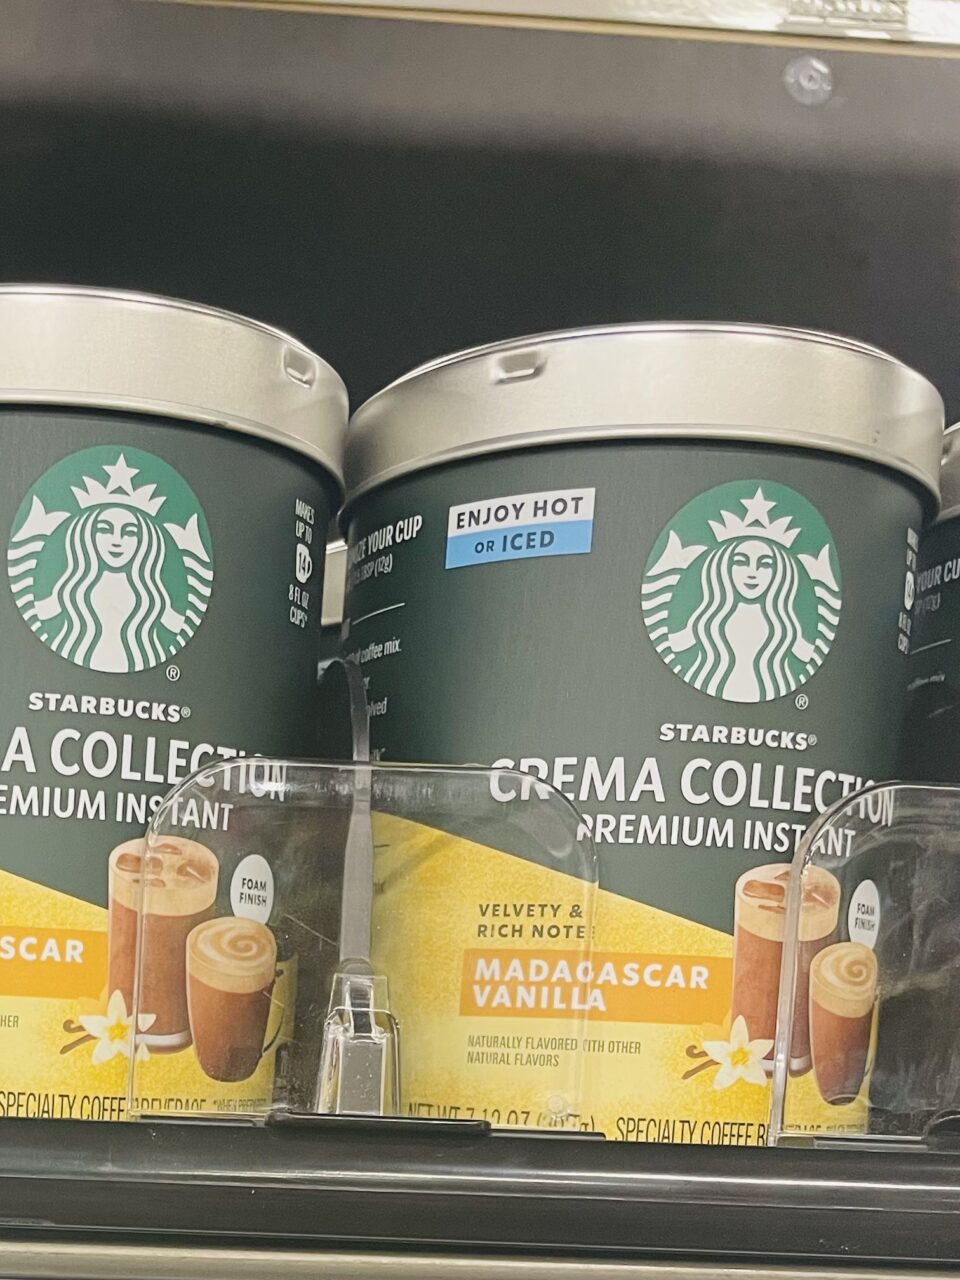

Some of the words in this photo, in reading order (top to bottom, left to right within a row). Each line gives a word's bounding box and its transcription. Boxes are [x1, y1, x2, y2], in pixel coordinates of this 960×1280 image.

[295, 498, 315, 525] MAKES
[456, 502, 526, 530] ENJOY
[532, 496, 584, 518] HOT
[367, 525, 393, 556] YOUR
[395, 514, 423, 544] CUP
[474, 540, 495, 554] OR
[502, 530, 555, 553] ICED
[360, 641, 383, 664] coffee
[51, 728, 286, 801] COLLECTION
[488, 756, 665, 802] CREMA
[680, 757, 895, 827] COLLECTION
[116, 792, 233, 831] INSTANT
[576, 813, 734, 849] PREMIUM
[743, 820, 856, 858] INSTANT
[241, 878, 267, 892] FOAM
[239, 892, 267, 907] FINISH
[478, 903, 562, 918] VELVETY
[569, 904, 583, 918] &
[476, 924, 523, 938] RICH
[474, 958, 709, 990] MADAGASCAR
[473, 985, 607, 1012] VANILLA
[467, 1035, 522, 1049] NATURALLY
[525, 1037, 578, 1051] FLAVORED
[608, 1041, 641, 1054] OTHER
[467, 1052, 511, 1066] NATURAL
[514, 1054, 560, 1067] FLAVORS
